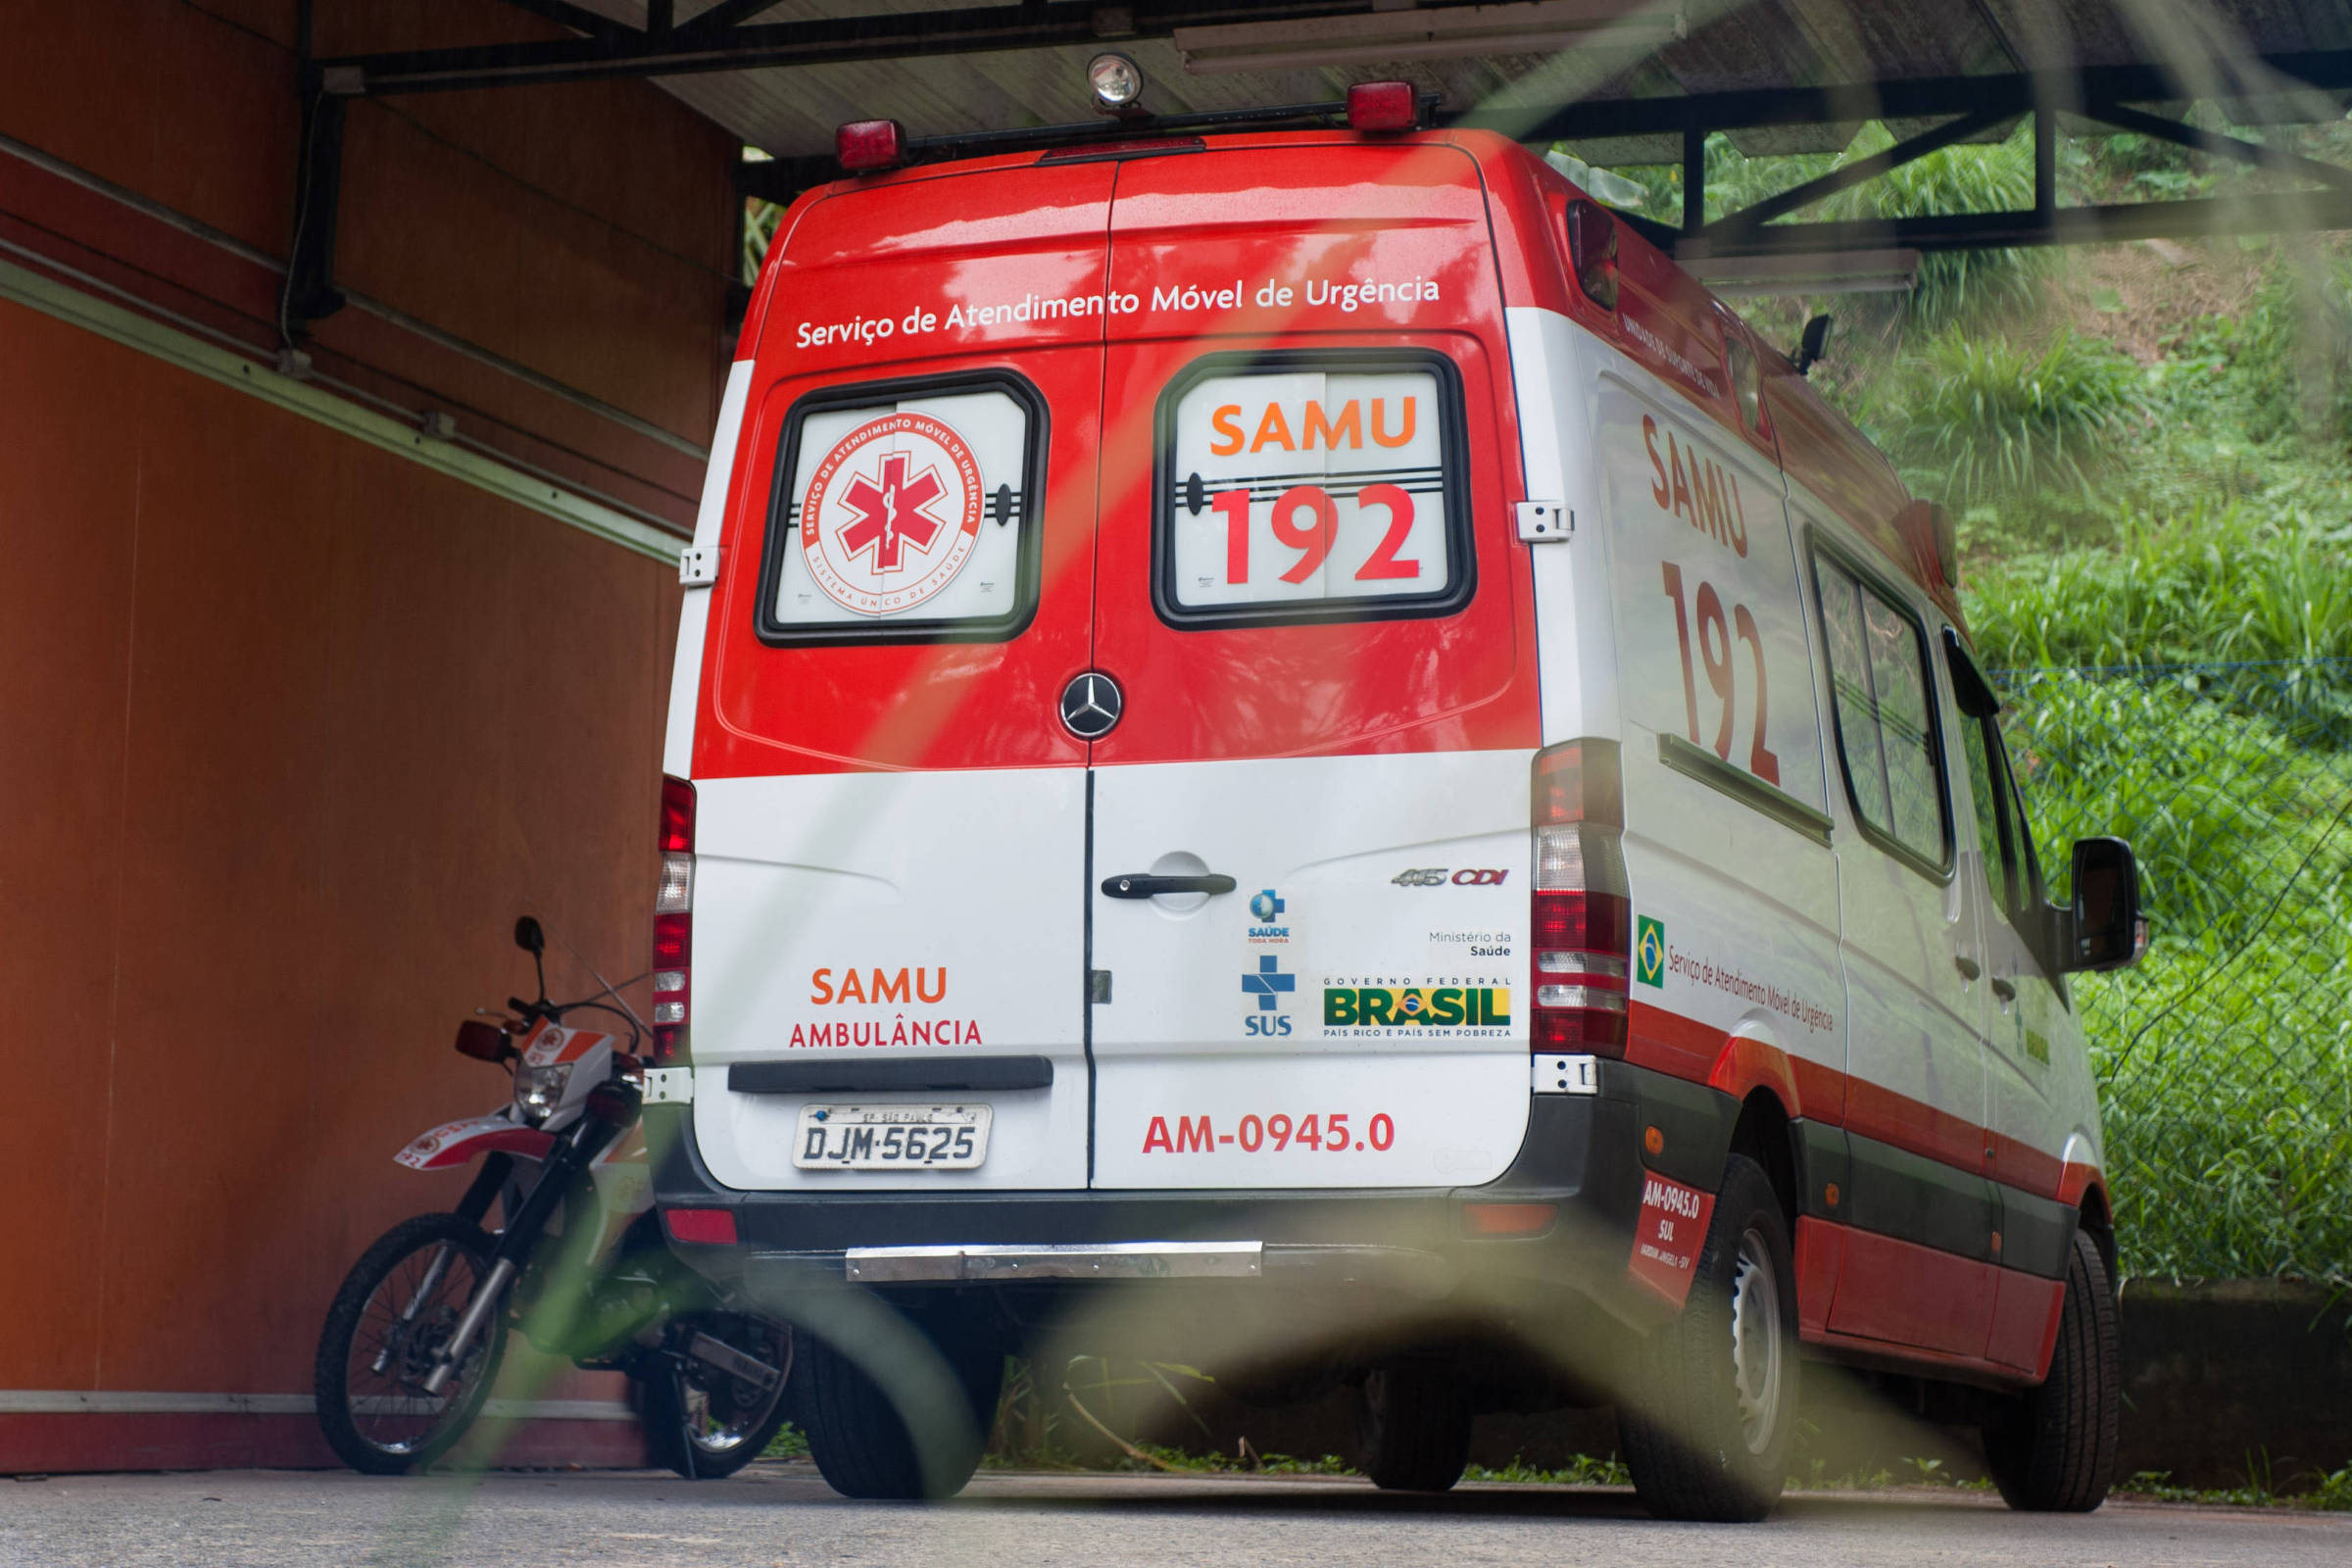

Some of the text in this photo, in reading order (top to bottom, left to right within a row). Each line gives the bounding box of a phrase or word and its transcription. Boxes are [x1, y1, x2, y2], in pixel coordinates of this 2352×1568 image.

[796, 275, 1440, 348] Serviço de Atendimento Móvel de Urgência
[1209, 396, 1418, 457] SAMU
[805, 417, 979, 535] SERVIÇO DE ATENDIMENTO MÓVEL DE URGÊNCIA
[1642, 414, 1748, 559] SAMU
[1211, 483, 1420, 584] 192
[812, 545, 965, 607] SISTEMA ÚNCO DE SAÚDE
[1661, 561, 1781, 787] 192
[1391, 868, 1510, 886] 415 CDI
[1248, 925, 1290, 938] SAÚDE
[1429, 932, 1511, 943] Ministério da
[1470, 946, 1511, 956] Saúde
[810, 966, 947, 1005] SAMU
[1323, 977, 1511, 986] GOVERNO FEDERAL
[1669, 945, 1834, 1034] Serviço de Atendimento Móvel de Urgência
[1245, 1015, 1292, 1037] SUS
[1323, 988, 1511, 1026] BRASIL
[789, 1013, 983, 1049] AMBULÂNCIA
[1323, 1027, 1511, 1037] PAÍS RICO É PAÍS SEM POBREZA
[1142, 1113, 1396, 1154] AM-0945.0
[1642, 1180, 1699, 1219] AM-0945.0
[1657, 1219, 1675, 1242] SUL
